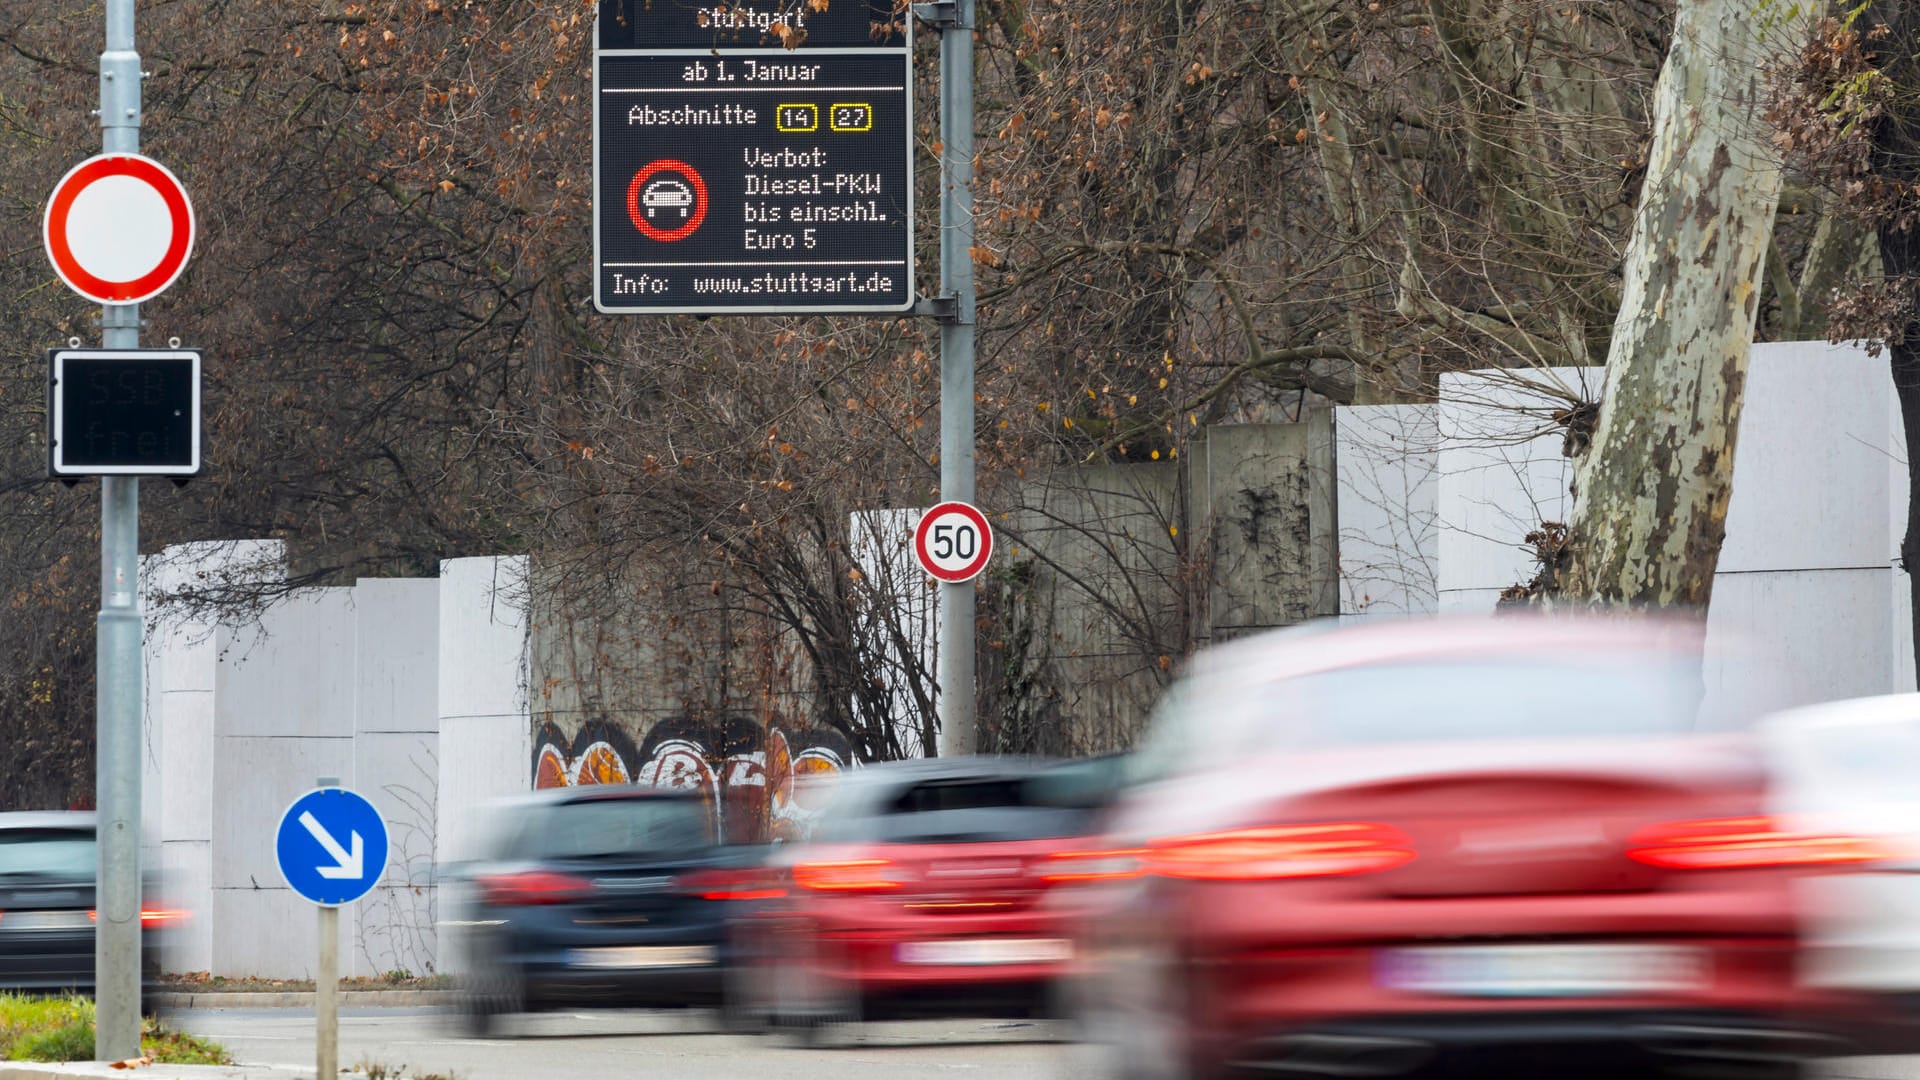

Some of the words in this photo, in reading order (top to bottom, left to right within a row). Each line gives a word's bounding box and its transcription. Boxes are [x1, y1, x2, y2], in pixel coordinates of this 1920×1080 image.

[681, 60, 708, 82] ab
[716, 60, 735, 81] 1.
[743, 60, 821, 81] Januar
[628, 103, 757, 125] Abschnitte
[784, 108, 808, 127] 14
[837, 108, 864, 126] 27
[744, 146, 827, 168] Verbot:
[744, 173, 881, 195] Diesel-PKW
[744, 201, 781, 223] bis
[790, 200, 887, 222] einschl.
[744, 228, 795, 250] Euro
[803, 228, 817, 249] 5
[613, 273, 669, 294] Info:
[693, 271, 893, 294] www.stuttgart.de
[89, 369, 164, 405] SSB
[85, 420, 169, 456] frei
[934, 525, 975, 559] 50
